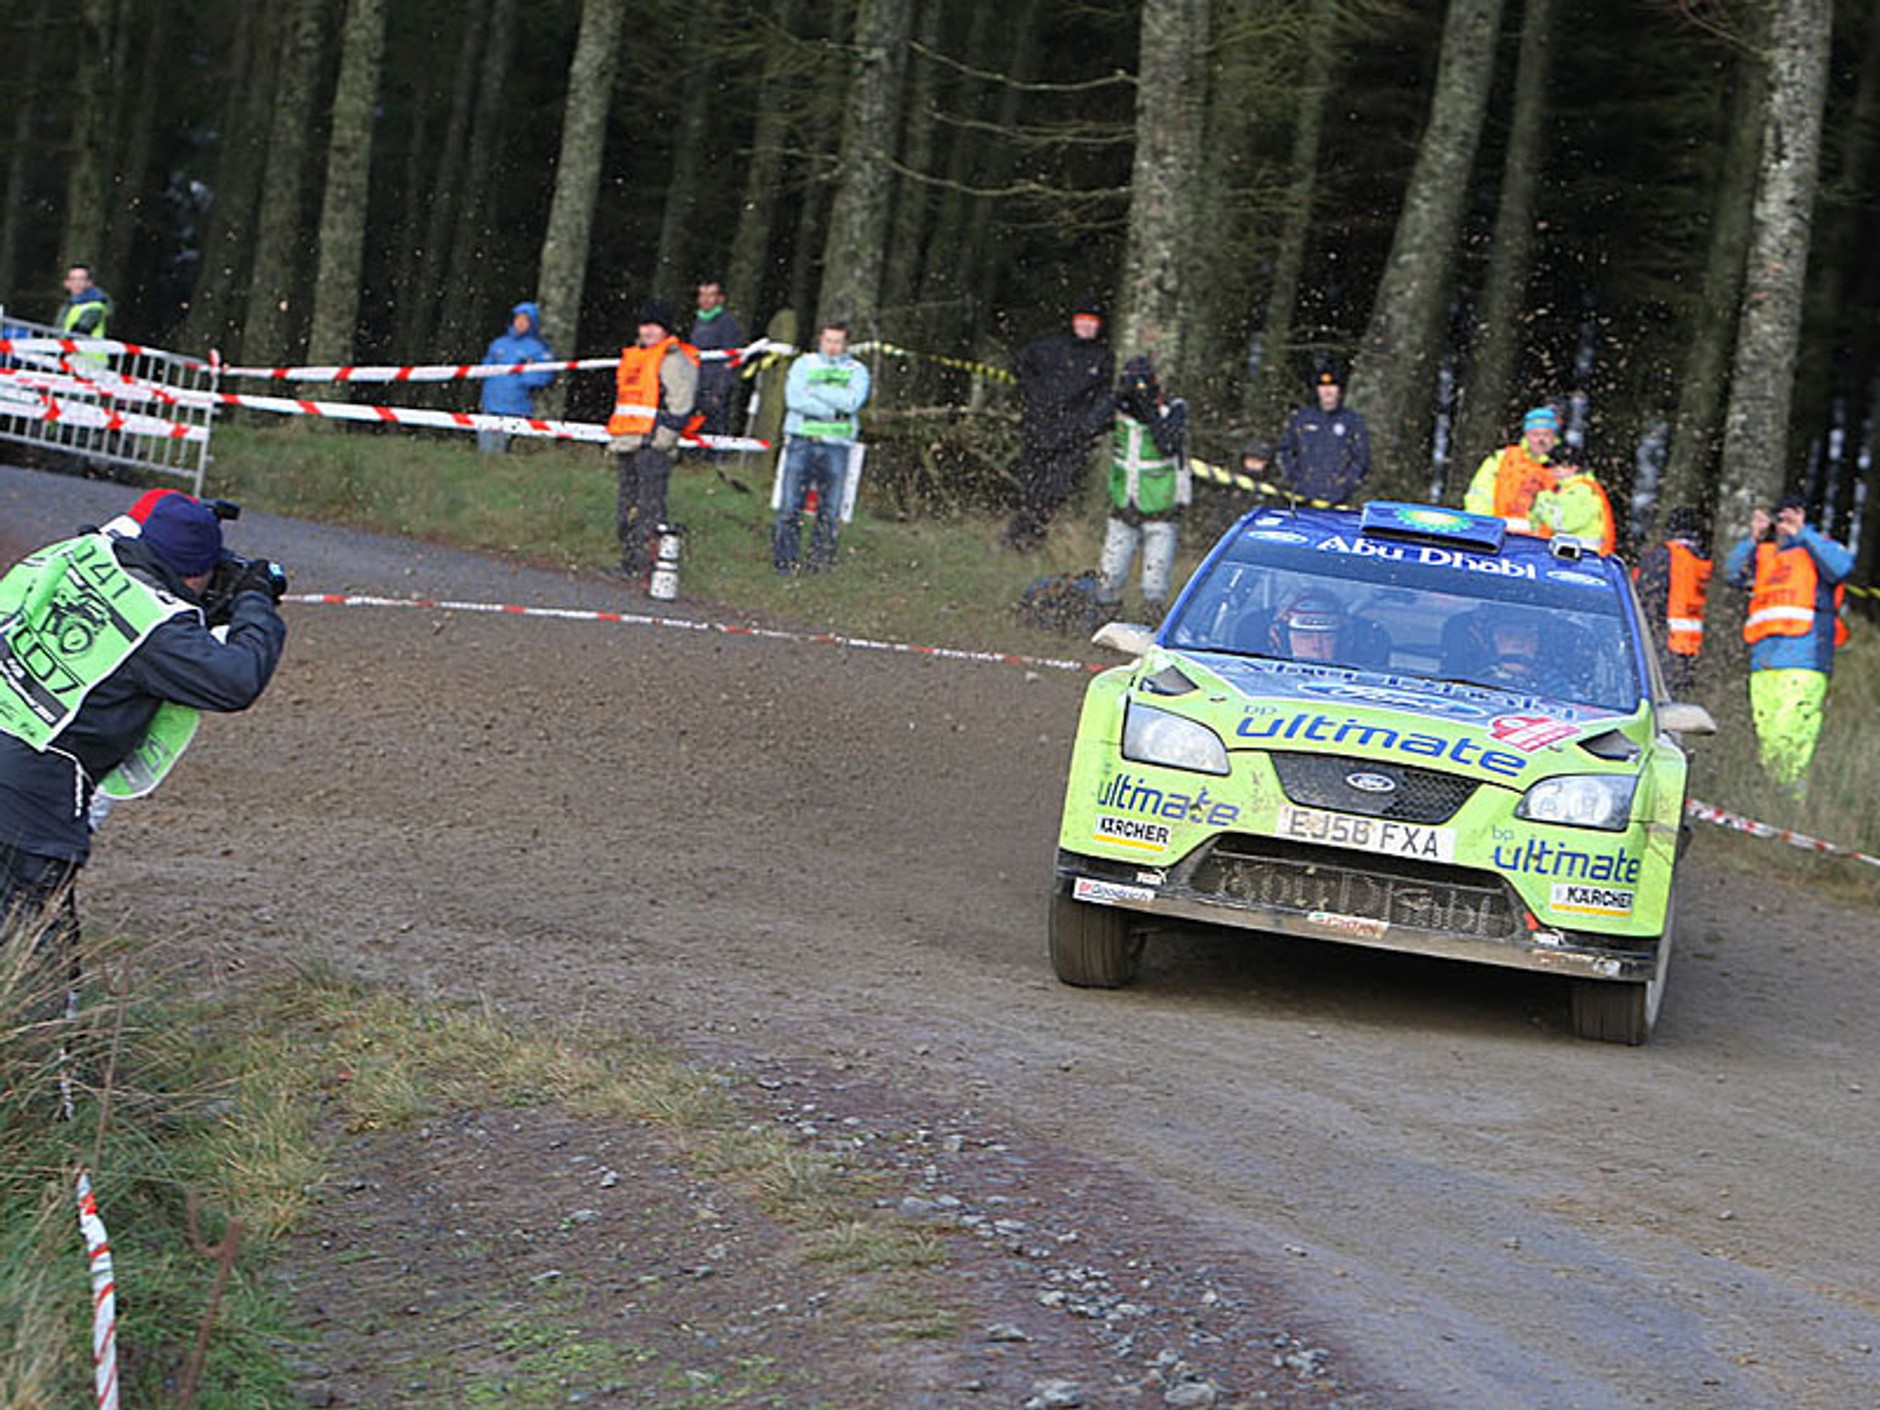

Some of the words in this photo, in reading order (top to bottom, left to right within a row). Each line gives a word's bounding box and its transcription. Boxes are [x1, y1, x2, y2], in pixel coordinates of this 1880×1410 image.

[73, 545, 131, 599] 141
[1316, 534, 1403, 561] Abu
[1419, 546, 1536, 580] Dhabi
[1236, 713, 1527, 777] ultimate
[1097, 773, 1240, 827] ultimate
[1379, 822, 1438, 857] FXA
[1492, 825, 1514, 843] bp
[1493, 838, 1641, 884] ultimate
